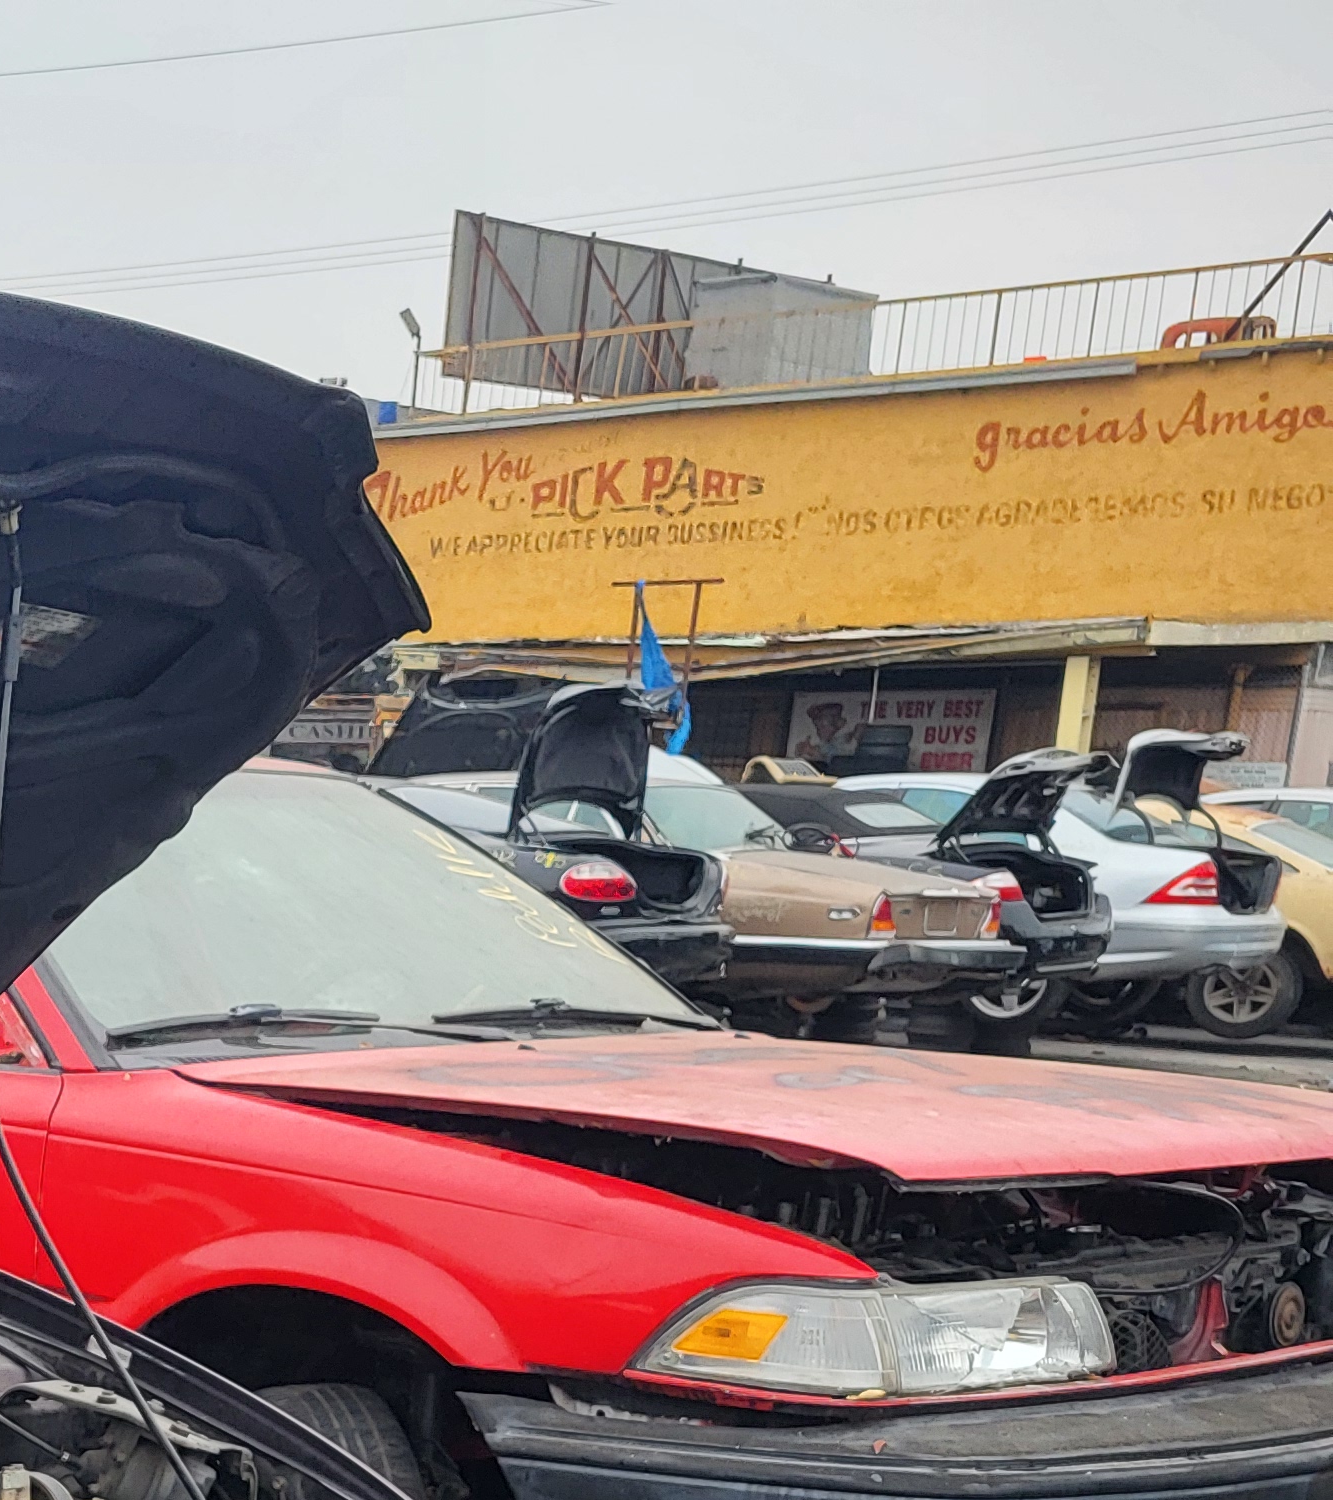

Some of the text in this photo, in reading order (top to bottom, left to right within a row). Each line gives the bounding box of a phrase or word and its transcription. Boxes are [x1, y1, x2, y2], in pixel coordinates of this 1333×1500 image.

[973, 388, 1333, 474] gracias Amigo
[363, 449, 536, 522] Thank You
[530, 457, 632, 524] PICK
[602, 523, 660, 551] YOUR
[895, 699, 936, 719] VERY
[942, 699, 984, 719] BEST
[923, 725, 977, 745] BUYS
